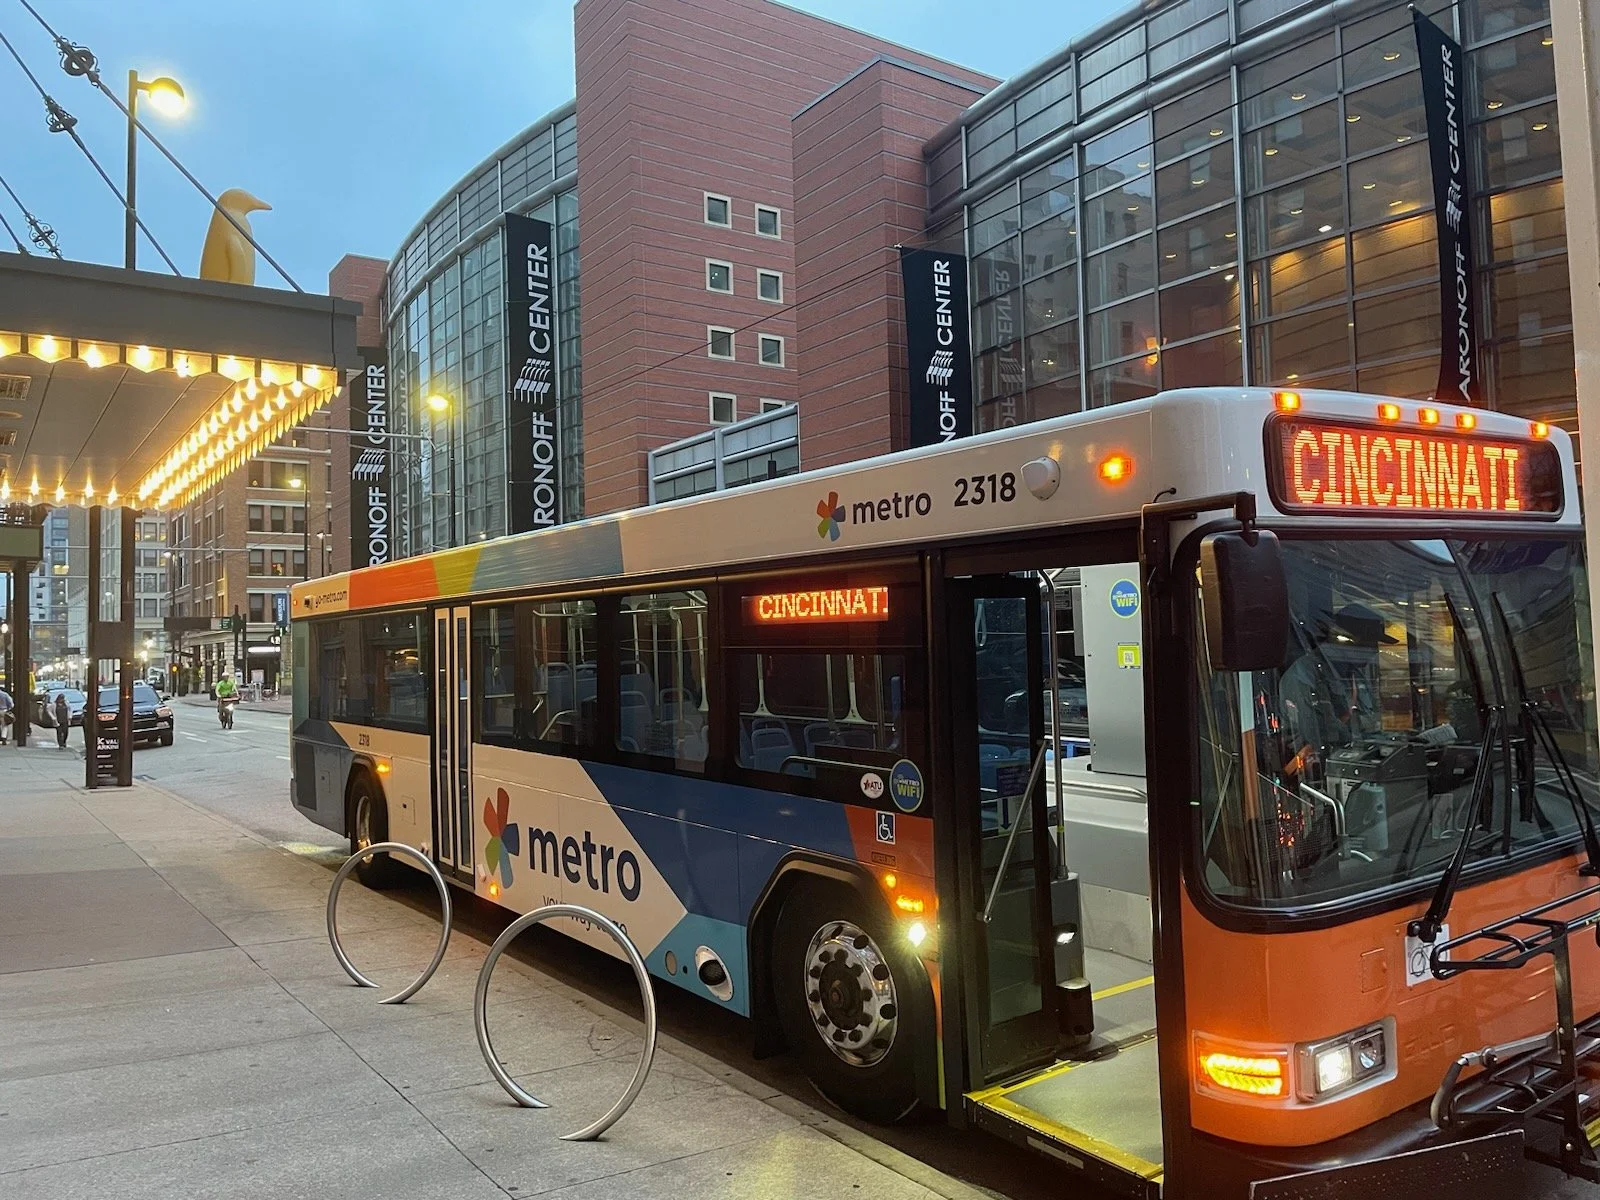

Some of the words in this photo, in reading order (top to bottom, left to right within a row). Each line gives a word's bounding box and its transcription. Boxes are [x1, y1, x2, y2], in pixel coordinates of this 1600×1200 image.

[1441, 44, 1460, 174] CENTER
[527, 243, 551, 354] CENTER
[933, 260, 953, 345] CENTER
[1454, 242, 1472, 402] ARONOFF
[367, 364, 386, 444] CENTER
[532, 411, 555, 526] RONOFF
[853, 492, 931, 524] metro
[954, 472, 1016, 507] 2318
[1293, 430, 1520, 511] CINCINNATI
[870, 781, 882, 790] ATU
[528, 827, 641, 901] metro
